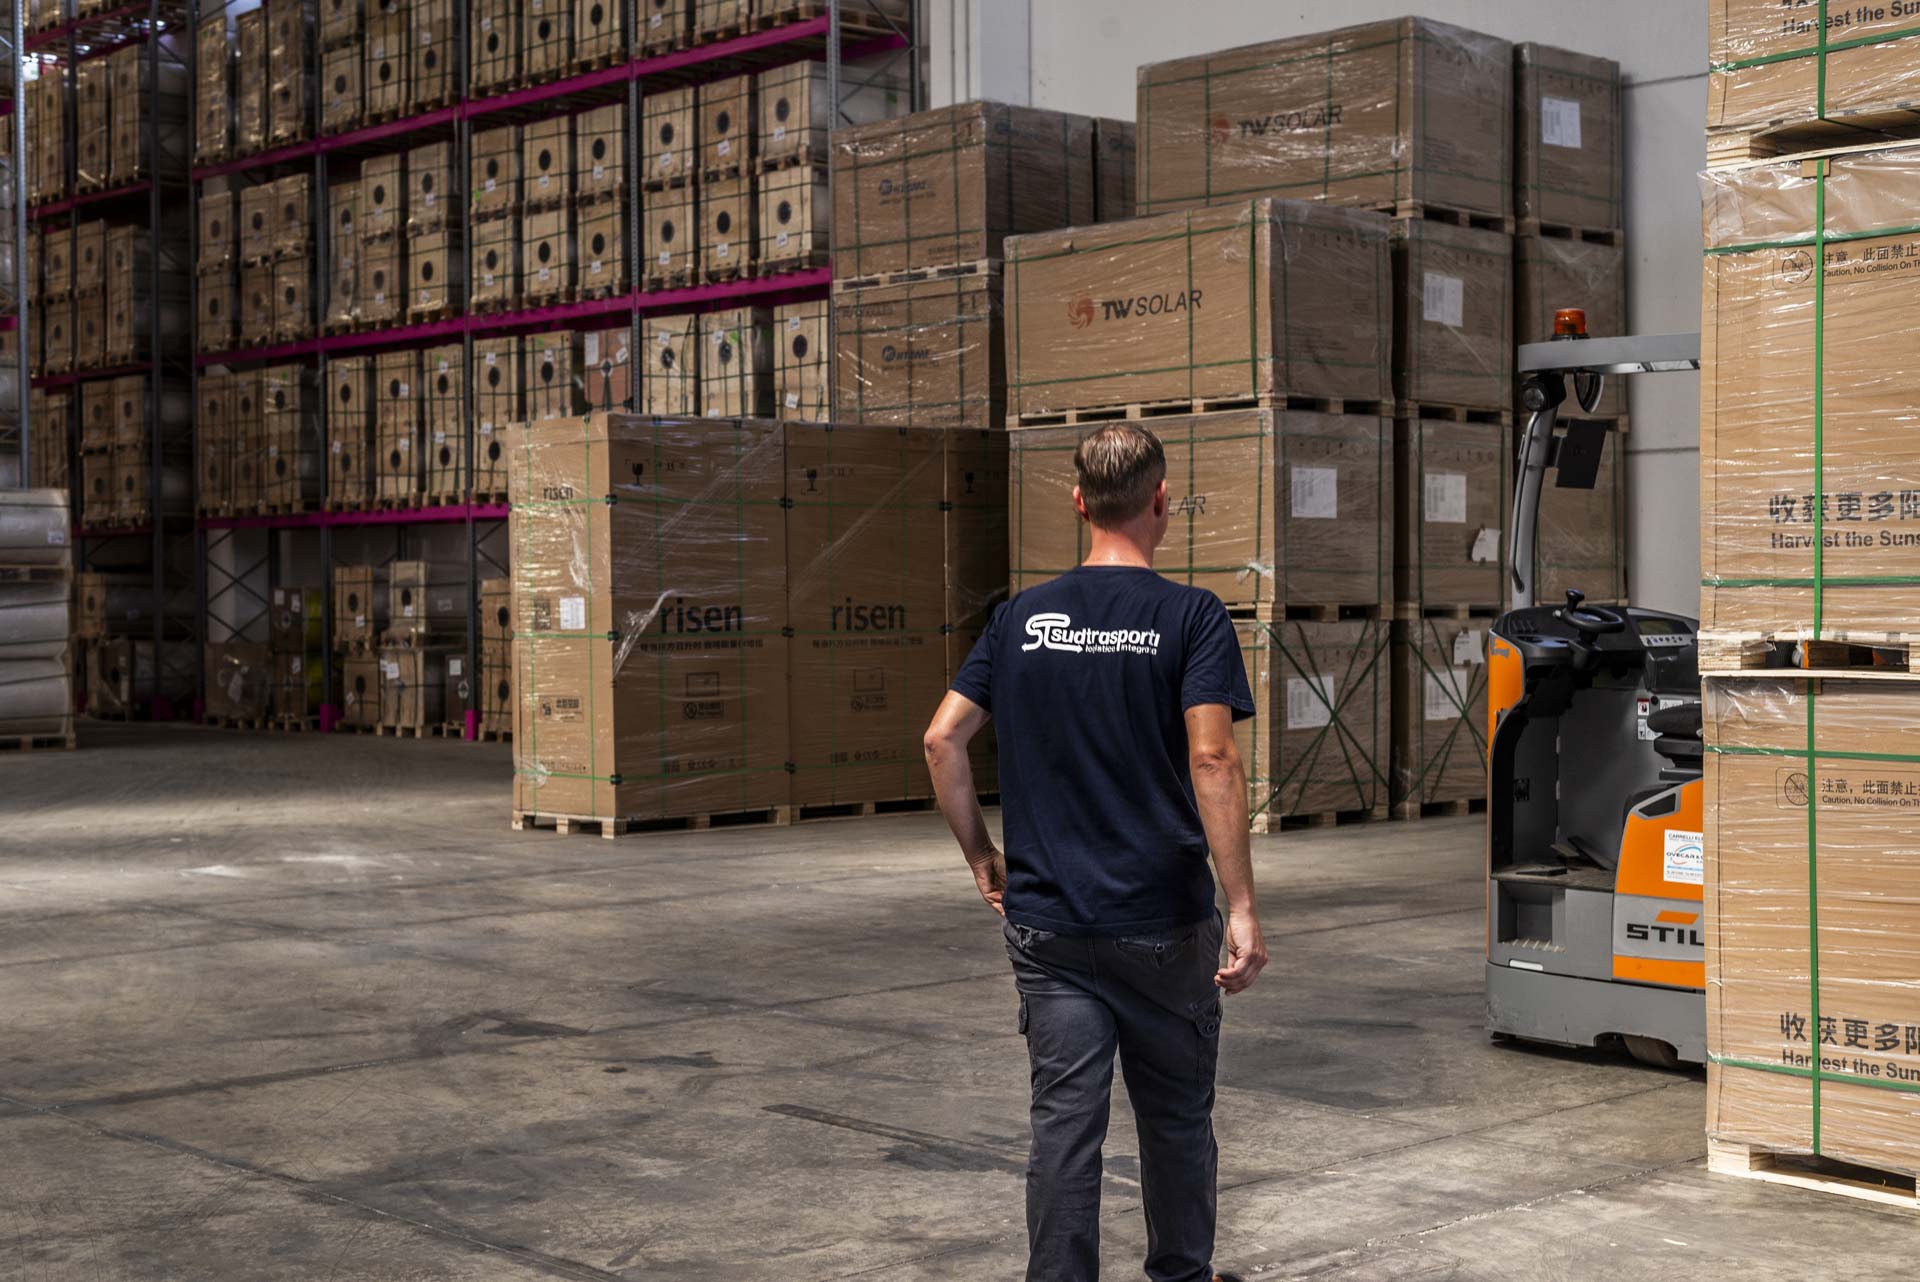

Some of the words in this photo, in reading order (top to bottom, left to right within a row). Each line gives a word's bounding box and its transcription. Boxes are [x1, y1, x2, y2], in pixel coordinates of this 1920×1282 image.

[1856, 6, 1885, 23] the
[1854, 265, 1865, 274] No
[1867, 261, 1898, 274] Collision
[1900, 260, 1912, 270] On
[1771, 531, 1840, 549] Harvst
[1845, 531, 1873, 547] the
[660, 597, 742, 634] risen
[831, 597, 905, 632] risen
[1822, 795, 1852, 805] Caution,
[1854, 796, 1865, 805] No
[1867, 796, 1898, 807] Collision
[1900, 797, 1912, 807] On
[1782, 1048, 1848, 1071] Harest
[1853, 1058, 1880, 1076] the
